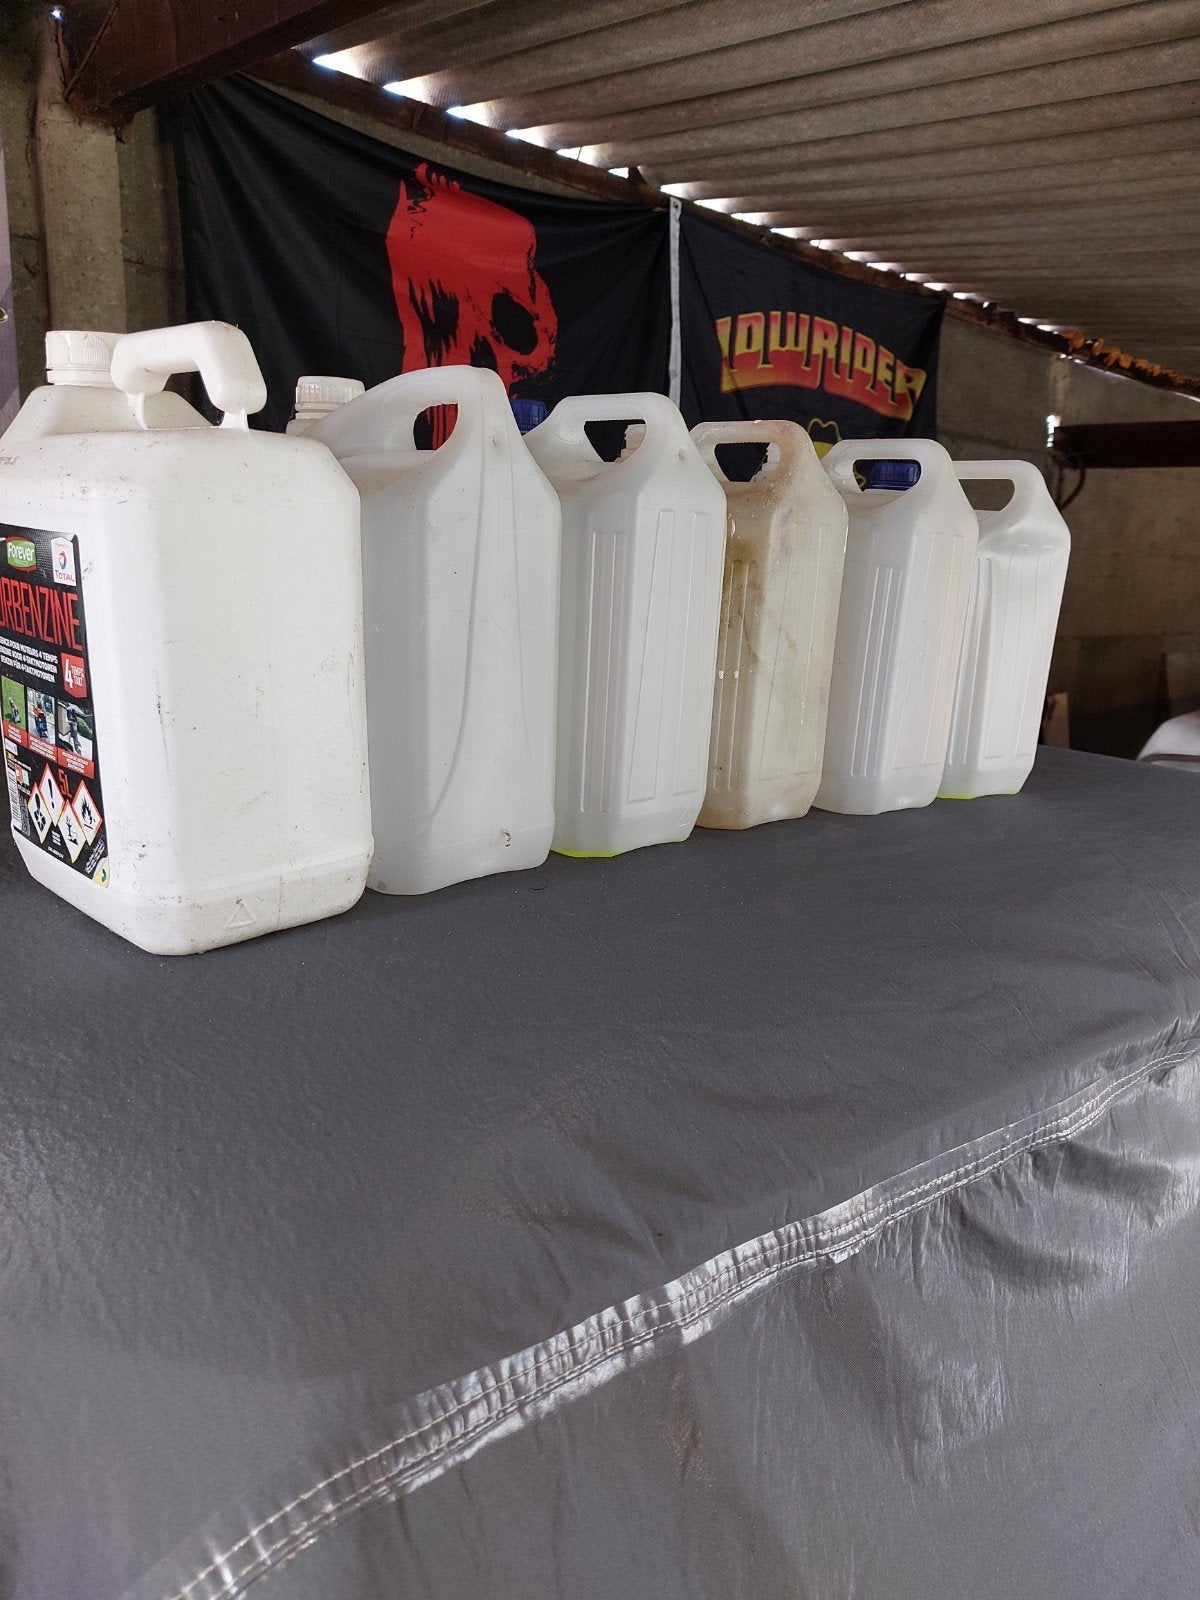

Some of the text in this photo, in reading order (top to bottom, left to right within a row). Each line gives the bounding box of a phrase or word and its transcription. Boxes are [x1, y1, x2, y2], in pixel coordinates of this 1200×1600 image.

[715, 311, 927, 422] LOWRIDER
[7, 541, 35, 562] Forever
[55, 569, 75, 582] TOTAL
[42, 651, 58, 664] TEMPS
[64, 658, 73, 688] 4
